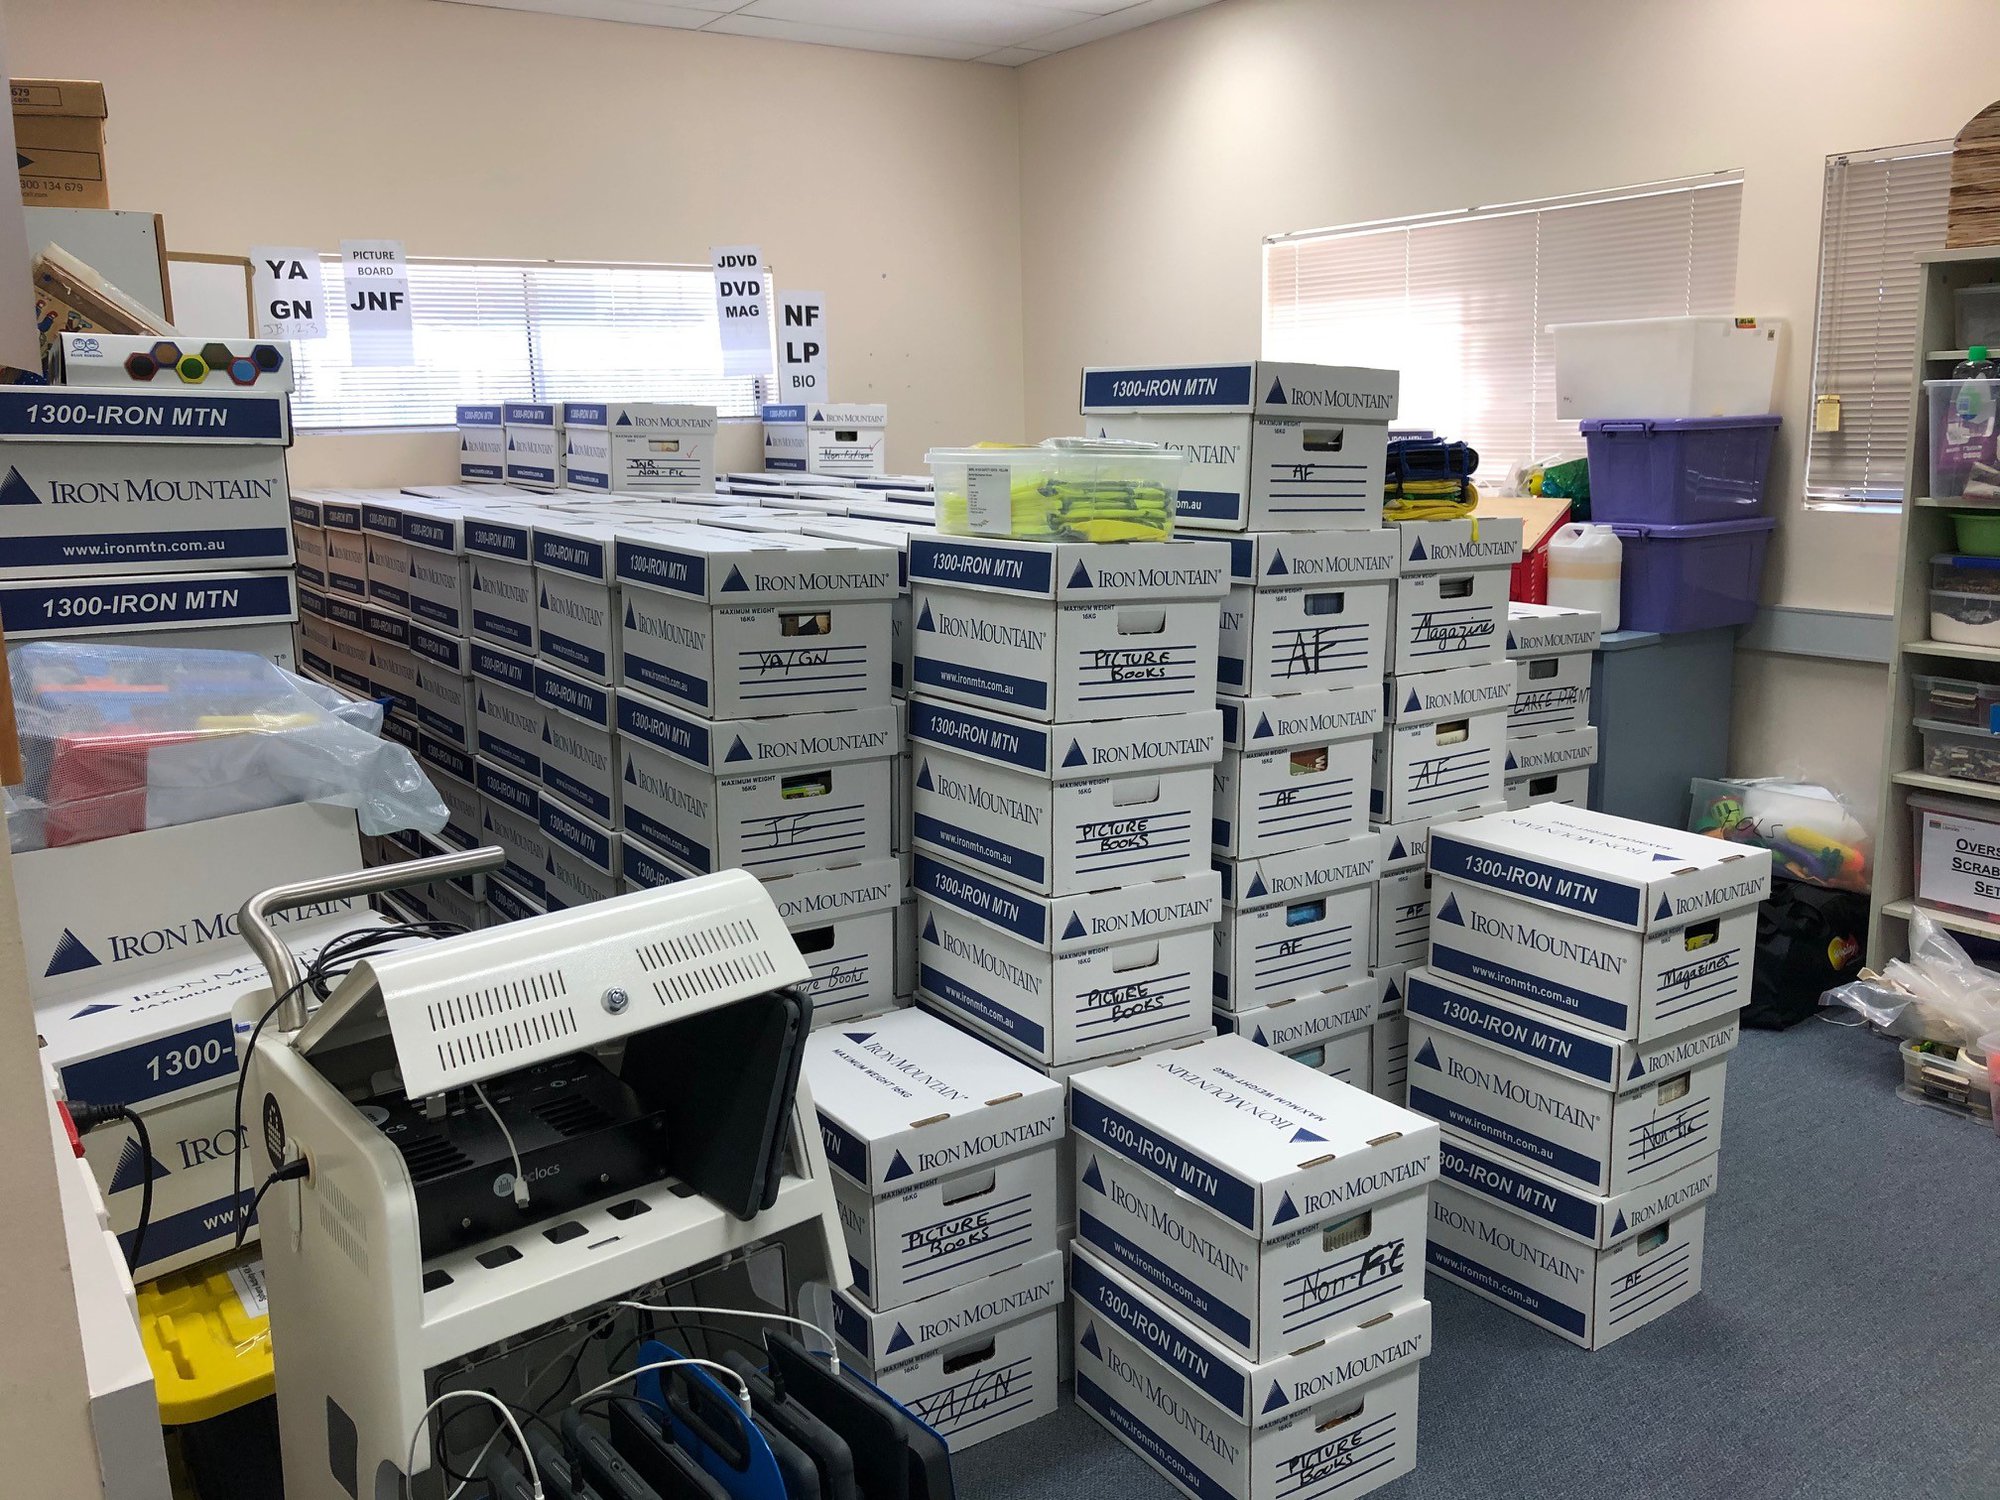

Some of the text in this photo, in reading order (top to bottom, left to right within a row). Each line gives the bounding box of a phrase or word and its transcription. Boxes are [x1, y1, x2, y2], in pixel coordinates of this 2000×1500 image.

[43, 181, 61, 190] 134
[64, 183, 83, 192] 679
[353, 251, 395, 260] PICTURE
[717, 255, 757, 268] JDVD
[266, 260, 308, 279] YA
[358, 267, 393, 276] BOARD
[351, 292, 404, 311] JNF
[720, 281, 760, 297] DVD
[270, 300, 313, 319] GN
[725, 305, 760, 318] MAG
[785, 305, 819, 327] NF
[786, 342, 819, 364] LP
[792, 375, 816, 388] BIO
[1112, 378, 1217, 397] 1300-IRON MTN
[1291, 388, 1390, 408] IRON MOUNTAIN
[26, 404, 228, 426] 1300-IRON MTN
[635, 416, 710, 427] IRON MOUNTAIN
[1293, 464, 1315, 481] AF
[48, 479, 271, 504] IRON MOUNTAIN
[62, 540, 225, 556] www.ironmtn.com.au
[1431, 542, 1515, 559] IRON MOUNTAIN
[631, 555, 687, 581] 1300-IRON MTN
[932, 554, 1023, 578] 1300-IRON MTN
[1293, 556, 1390, 574] IRON MOUNTAIN
[1098, 570, 1218, 587] IRON MOUNTAIN
[42, 589, 238, 618] 1300-IRON MTN
[939, 613, 1043, 651] IRON MOUNTAIN
[1414, 614, 1495, 650] Magazines
[1095, 650, 1170, 668] PICTURE
[1287, 626, 1339, 679] AF
[941, 671, 1014, 695] www.ironmtn.com.au
[632, 711, 690, 749] 1300-IRON MTN
[930, 716, 1018, 753] 1300-IRON MTN
[1093, 738, 1210, 764] IRON MOUNTAIN
[721, 775, 775, 787] MAXIMUM WEIGHT
[1416, 758, 1450, 789] AF
[938, 774, 1039, 826] IRON MOUNTAIN
[1277, 790, 1299, 805] AF
[1082, 819, 1148, 840] PICTURE
[940, 830, 1012, 864] www.ironmtn.com.au
[1101, 833, 1149, 852] BOOKS
[1464, 854, 1598, 904] 1300-IRON MTN
[778, 886, 887, 918] ON MOUNTAIN
[935, 873, 1018, 922] 1300-IRON MTN
[1676, 878, 1762, 916] IRON MOUNTAIN
[1092, 901, 1209, 934] IRON MOUNTAIN
[108, 925, 188, 962] IRON
[1059, 946, 1109, 960] MAXIMUM WEIGHT
[1280, 938, 1303, 954] AF
[1470, 911, 1622, 975] IRON MOUNTAIN
[943, 930, 1039, 995] IRON MOUNTAIN
[1472, 964, 1579, 1008] www.ironmtn.com.au
[945, 985, 1014, 1029] www.ironmtn.com.au
[1442, 1000, 1572, 1059] 1300-IRON MTN
[1447, 1057, 1595, 1132] IRON MOUNTAIN
[918, 1118, 1050, 1172] IRON MOUNTAIN
[1449, 1110, 1554, 1160] www.ironmtn.com.au
[1101, 1116, 1218, 1197] 1300-IRON MTN
[881, 1178, 938, 1200] MAXIMUM WEIGHT
[1304, 1158, 1427, 1214] IRON MOUNTAIN
[1439, 1150, 1556, 1213] 300-IRON MTN
[909, 1212, 990, 1250] PICTURE
[1266, 1223, 1319, 1247] MAXIMUM WEIGHT
[1114, 1241, 1208, 1311] www.ironmtn.com.au
[1435, 1251, 1539, 1309] www.ironmtn.com.au
[1625, 1271, 1642, 1289] AF
[919, 1282, 1051, 1342] IRON MOUNTAIN
[1099, 1286, 1209, 1379] 1300-IRON MTN
[883, 1350, 938, 1374] MAXIMUM WEIGHT
[1107, 1348, 1235, 1465] IRON MOUNTAIN
[1109, 1406, 1199, 1488] www.ironmtn.com.au
